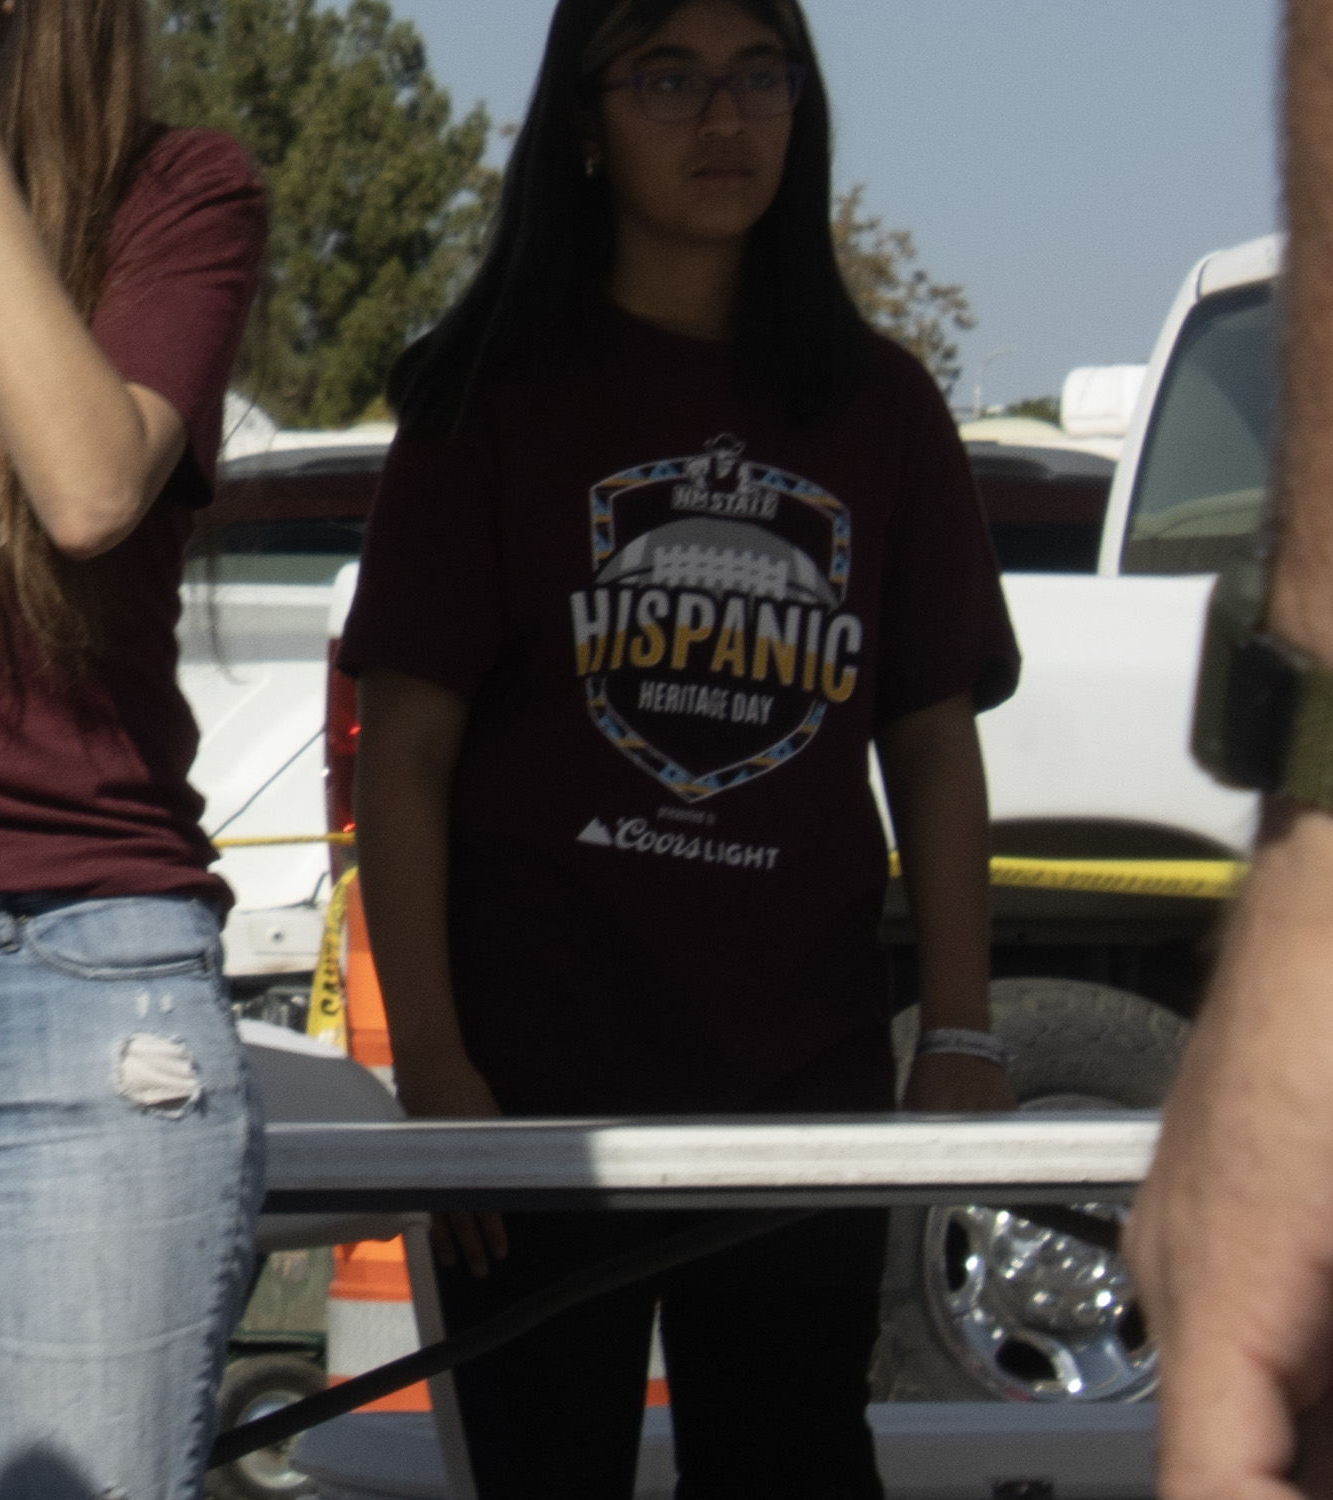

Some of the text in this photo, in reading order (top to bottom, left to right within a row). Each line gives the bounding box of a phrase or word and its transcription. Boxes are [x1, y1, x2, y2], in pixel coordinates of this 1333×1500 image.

[569, 588, 862, 703] HISPANIC
[637, 679, 774, 726] HERITAGE DAY
[614, 816, 781, 871] Coors LIGHT
